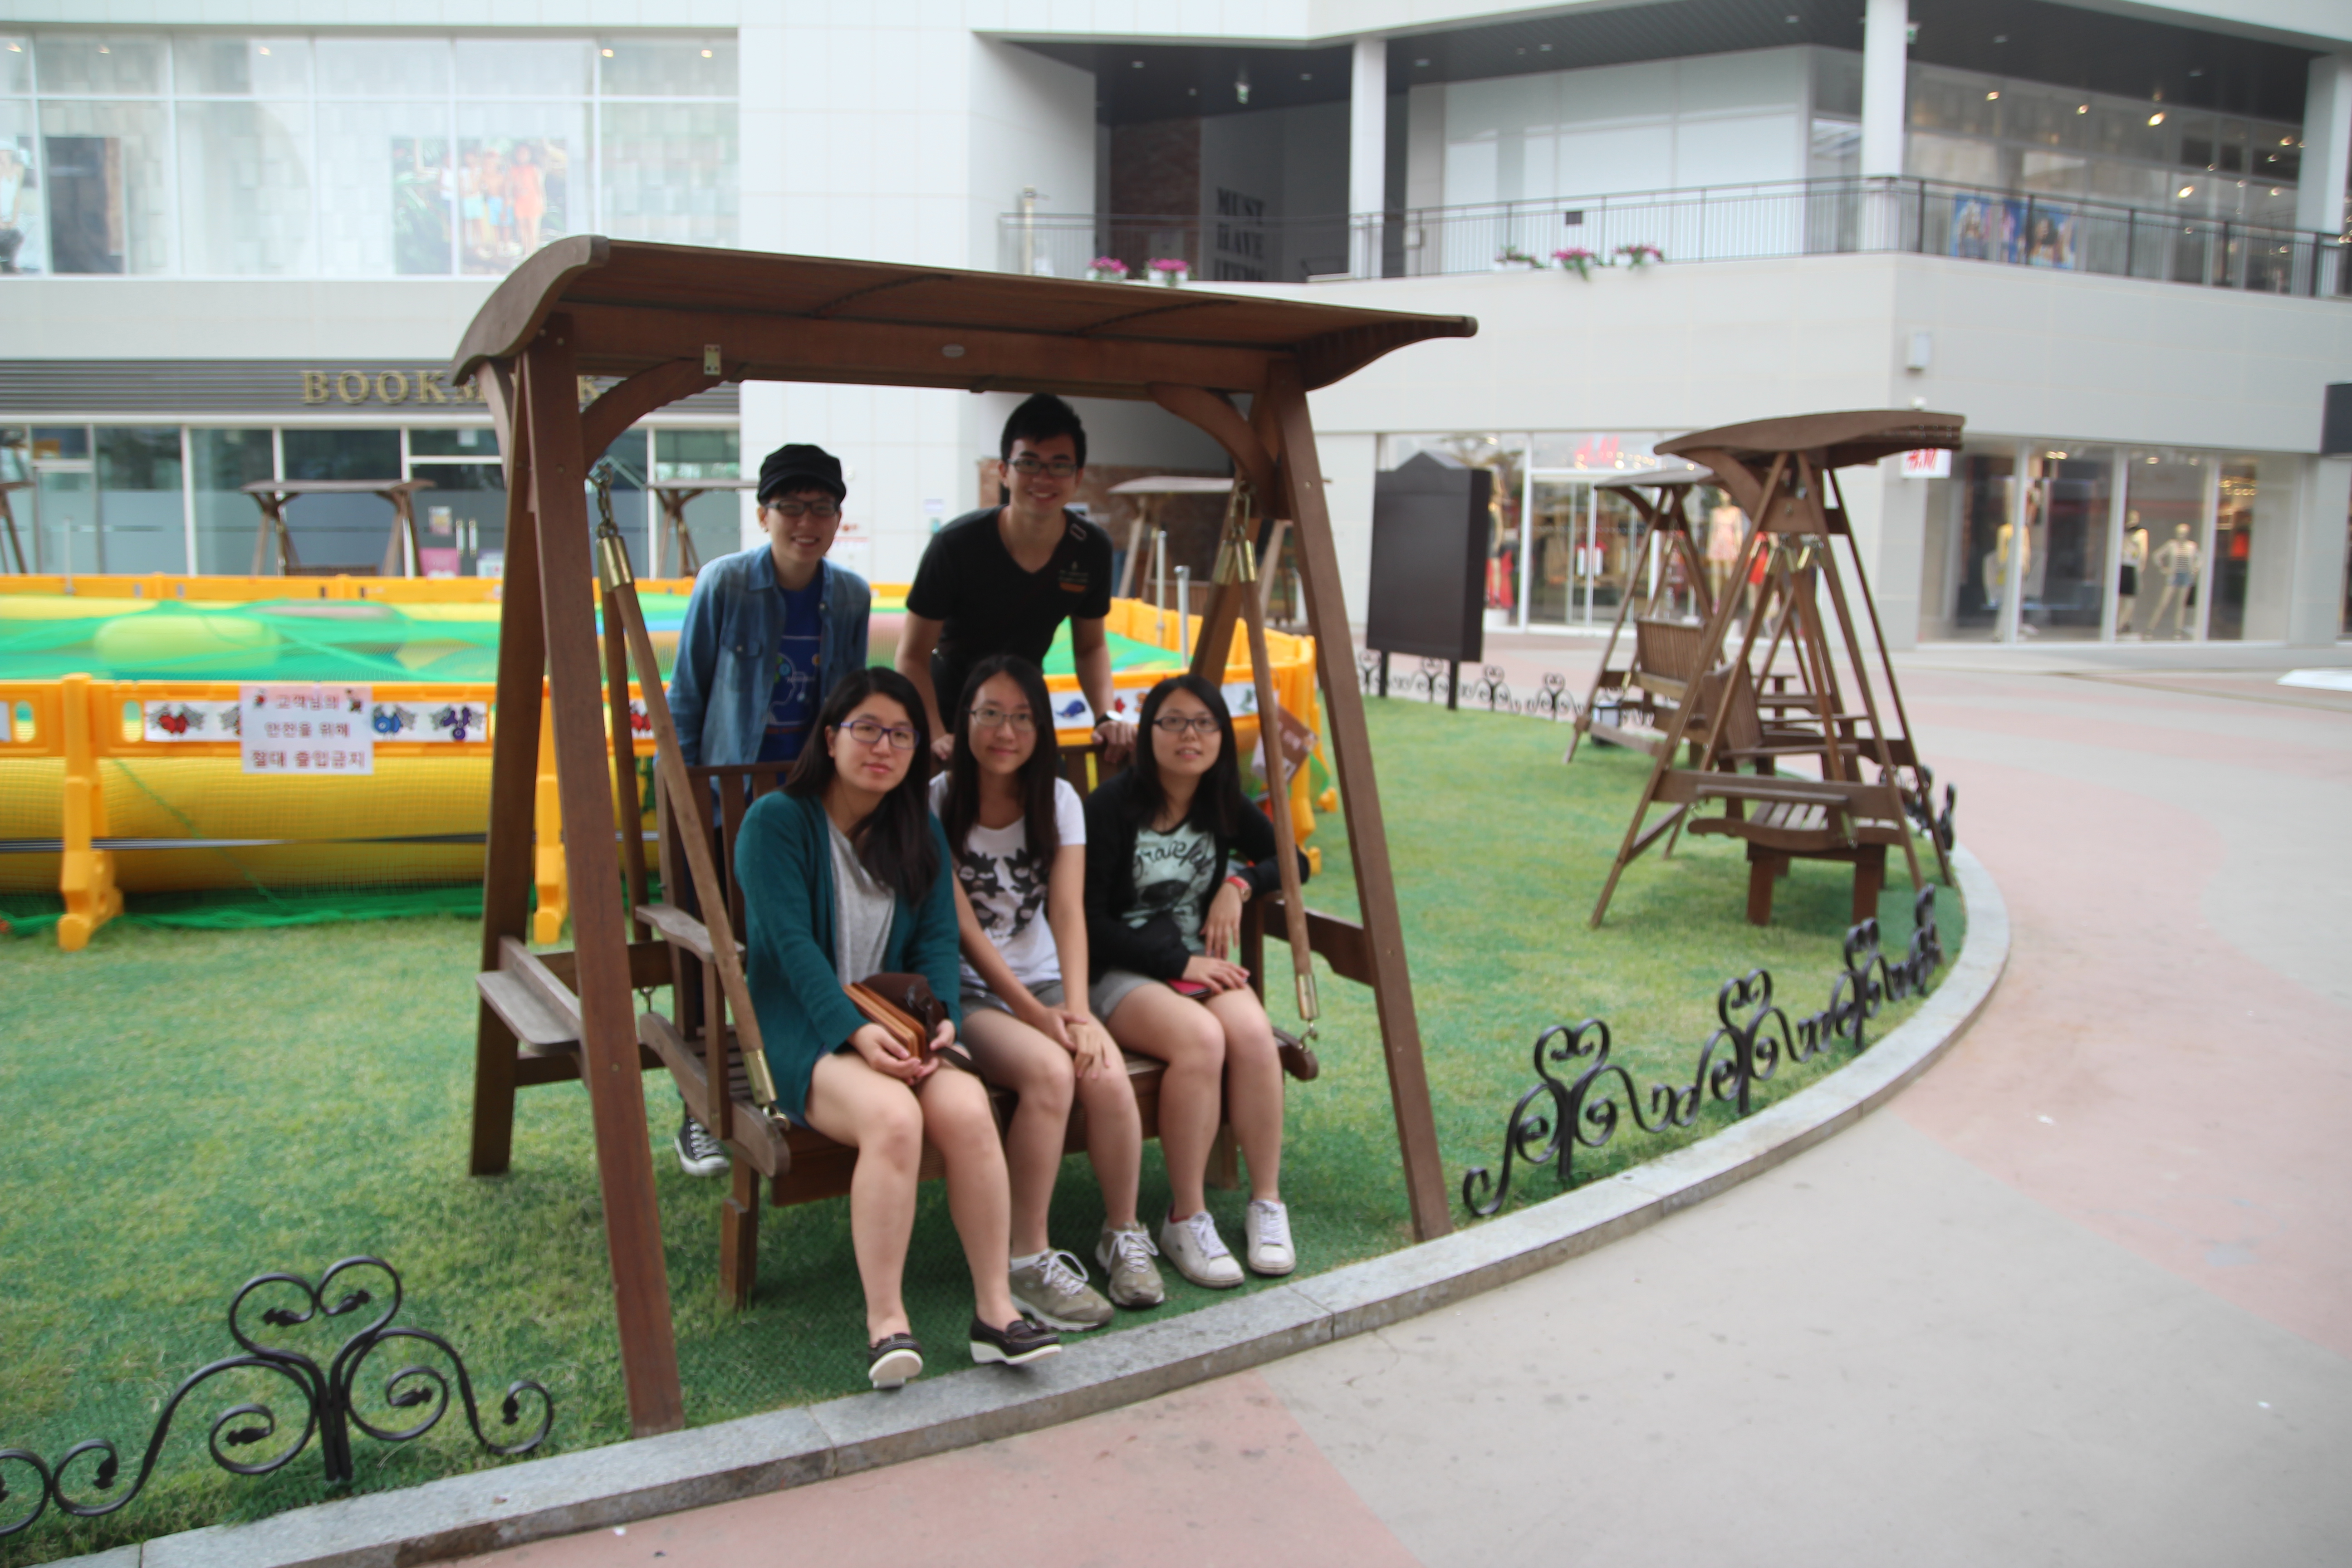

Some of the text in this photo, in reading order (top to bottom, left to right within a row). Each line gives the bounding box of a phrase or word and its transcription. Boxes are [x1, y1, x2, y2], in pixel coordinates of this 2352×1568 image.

[277, 696, 338, 709] 고객님의
[266, 722, 349, 738] 안전을 위해
[253, 750, 364, 768] 절대 출입금지
